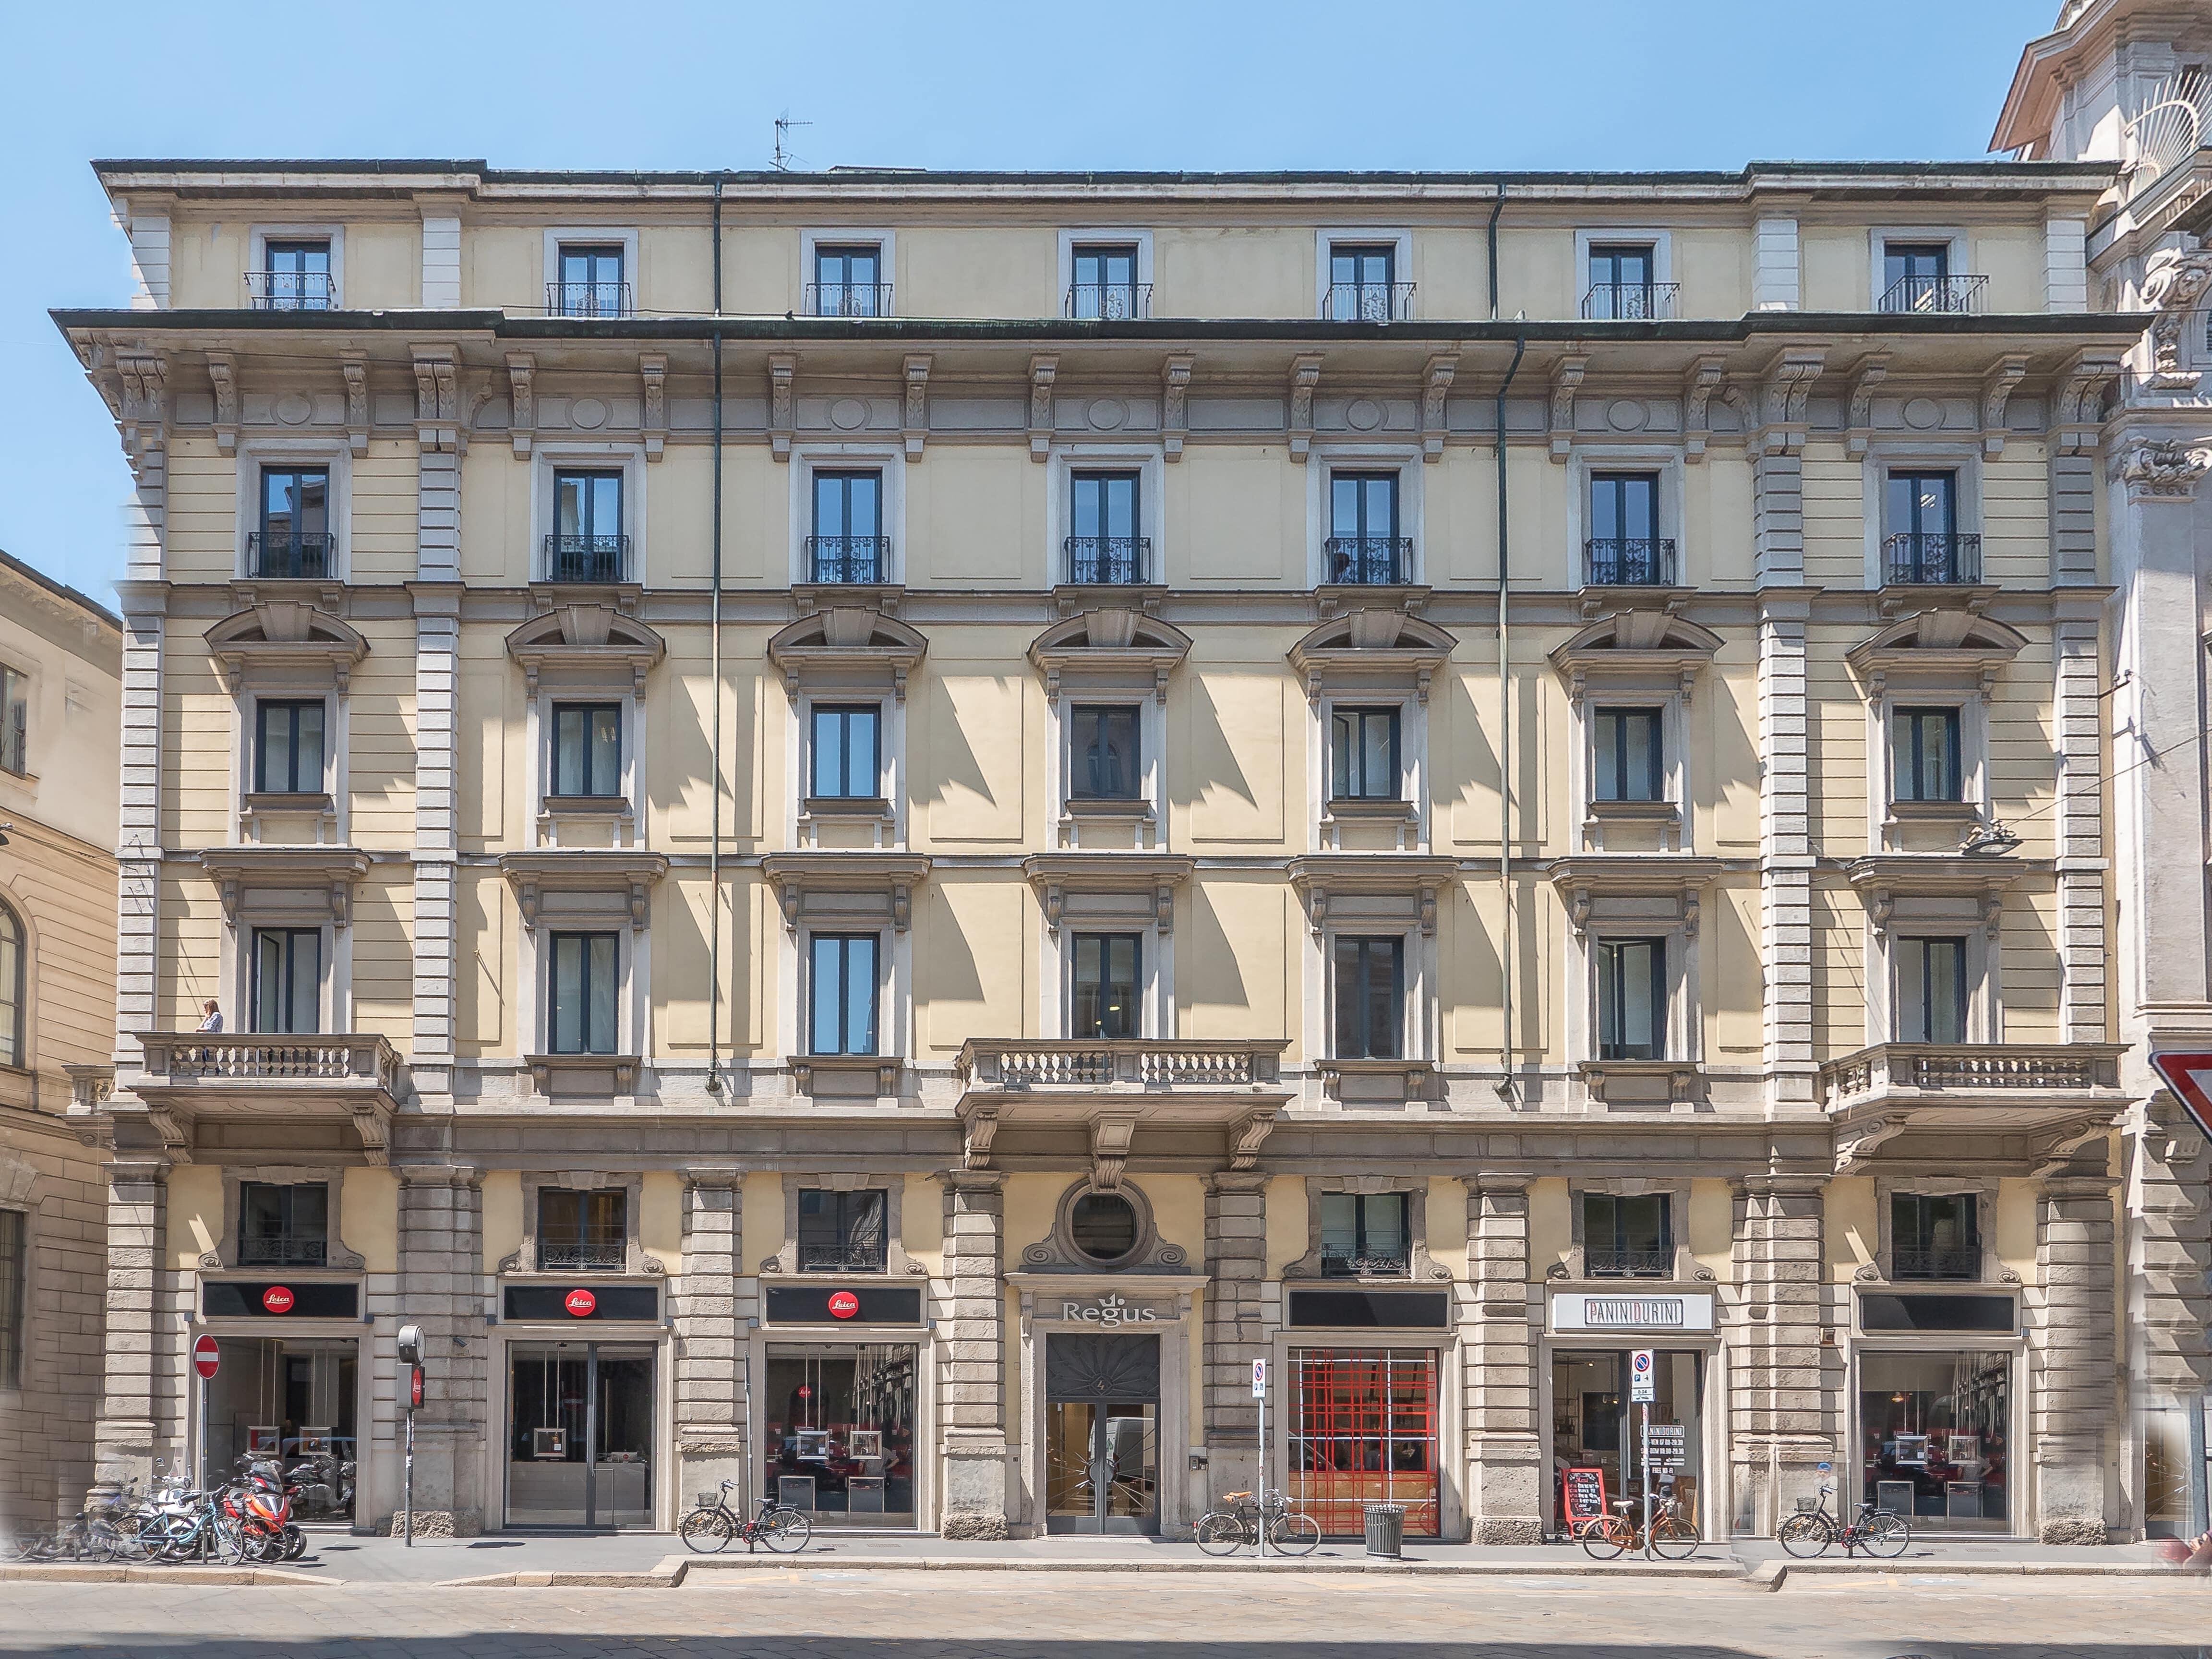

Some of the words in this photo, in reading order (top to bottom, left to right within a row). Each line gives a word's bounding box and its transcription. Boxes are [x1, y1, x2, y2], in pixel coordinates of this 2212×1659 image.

[266, 1294, 290, 1304] Leica
[568, 1297, 592, 1308] Leica
[831, 1299, 856, 1310] Leica
[1062, 1302, 1156, 1328] Regus
[1590, 1302, 1678, 1323] PANINIDURINI
